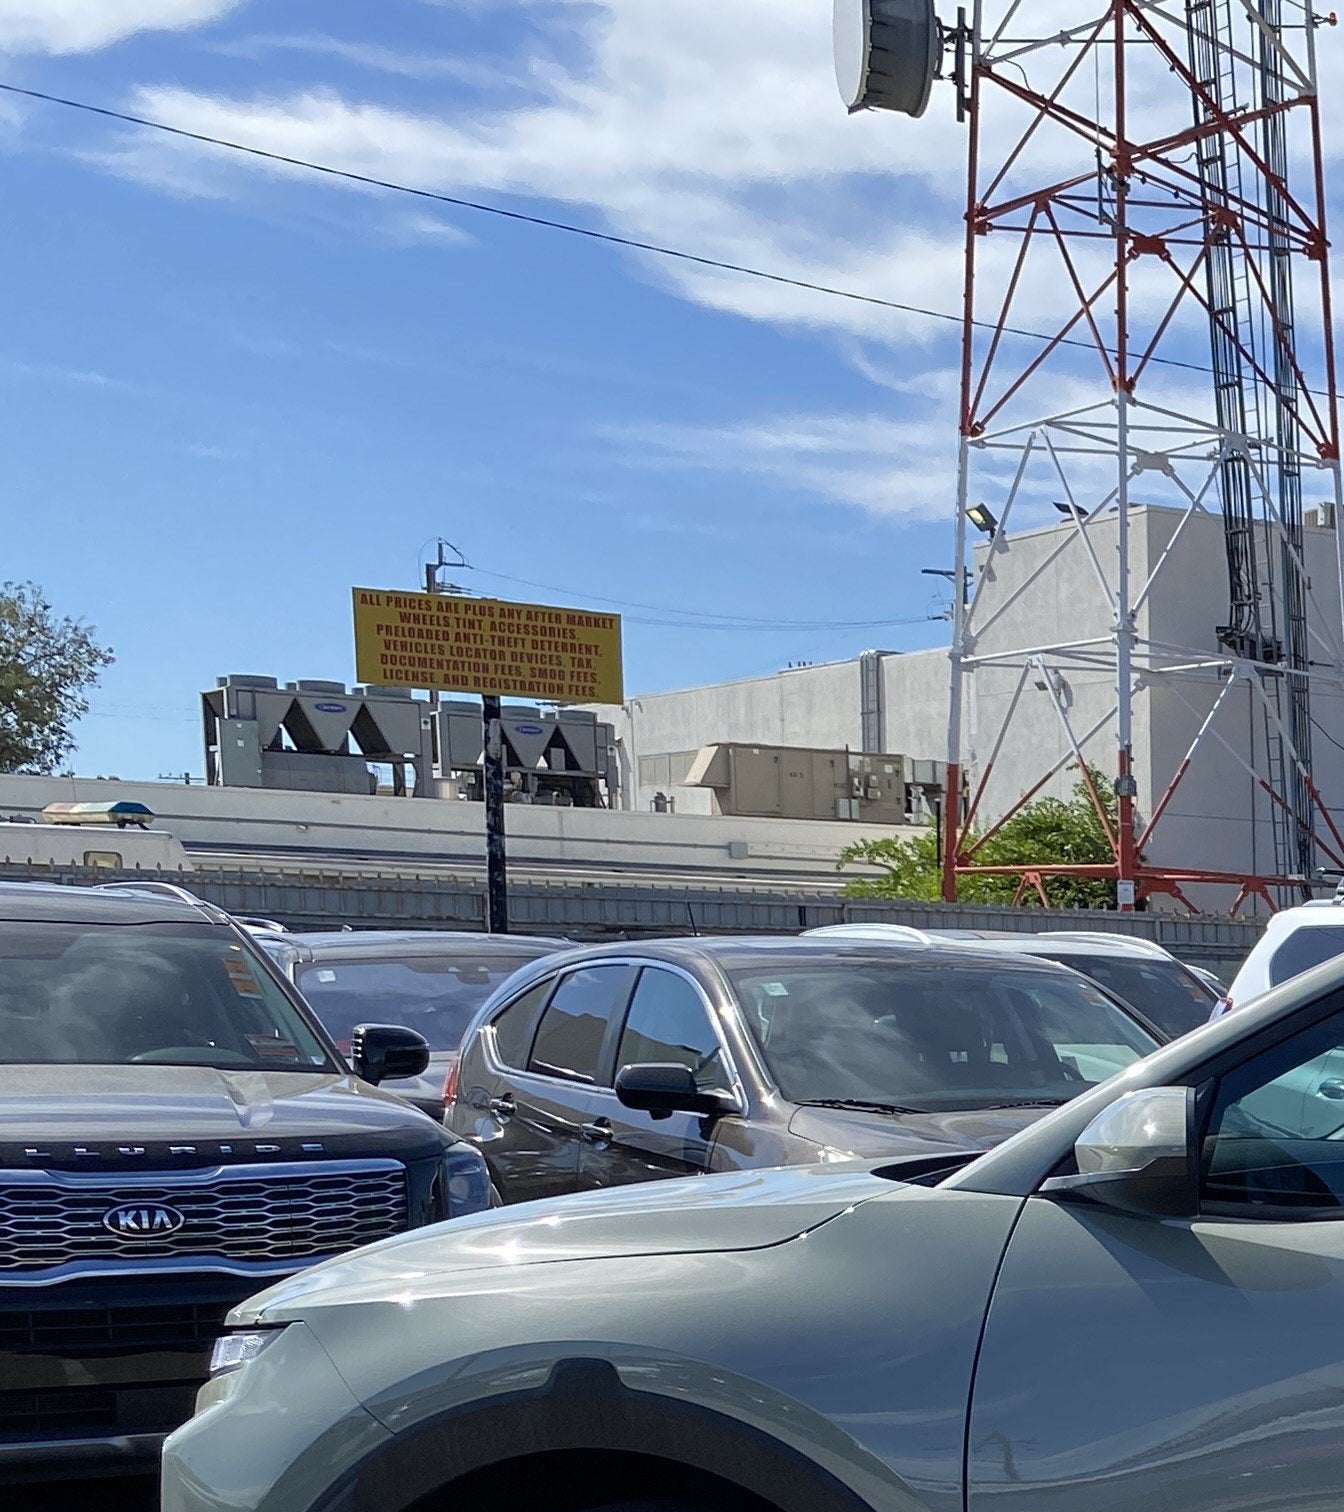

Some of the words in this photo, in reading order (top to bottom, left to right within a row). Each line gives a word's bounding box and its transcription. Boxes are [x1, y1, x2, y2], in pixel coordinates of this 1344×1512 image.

[359, 592, 381, 606] ALL
[385, 595, 432, 611] PRICES
[436, 600, 460, 614] ARE
[464, 603, 494, 617] PLUS
[498, 607, 522, 620] ANY
[525, 609, 561, 624] AFTER
[566, 613, 614, 629] MARKET
[375, 623, 449, 641] PRELOADED
[453, 631, 526, 649] ANTI-THEFT
[383, 638, 445, 655] VEHICLES
[449, 645, 505, 661] LOCATOR
[379, 653, 489, 673] DOCUMENTATION
[529, 666, 565, 680] SMOG
[442, 673, 468, 686] AND
[473, 675, 564, 694] REGISTRATION
[117, 1209, 173, 1231] KIA
